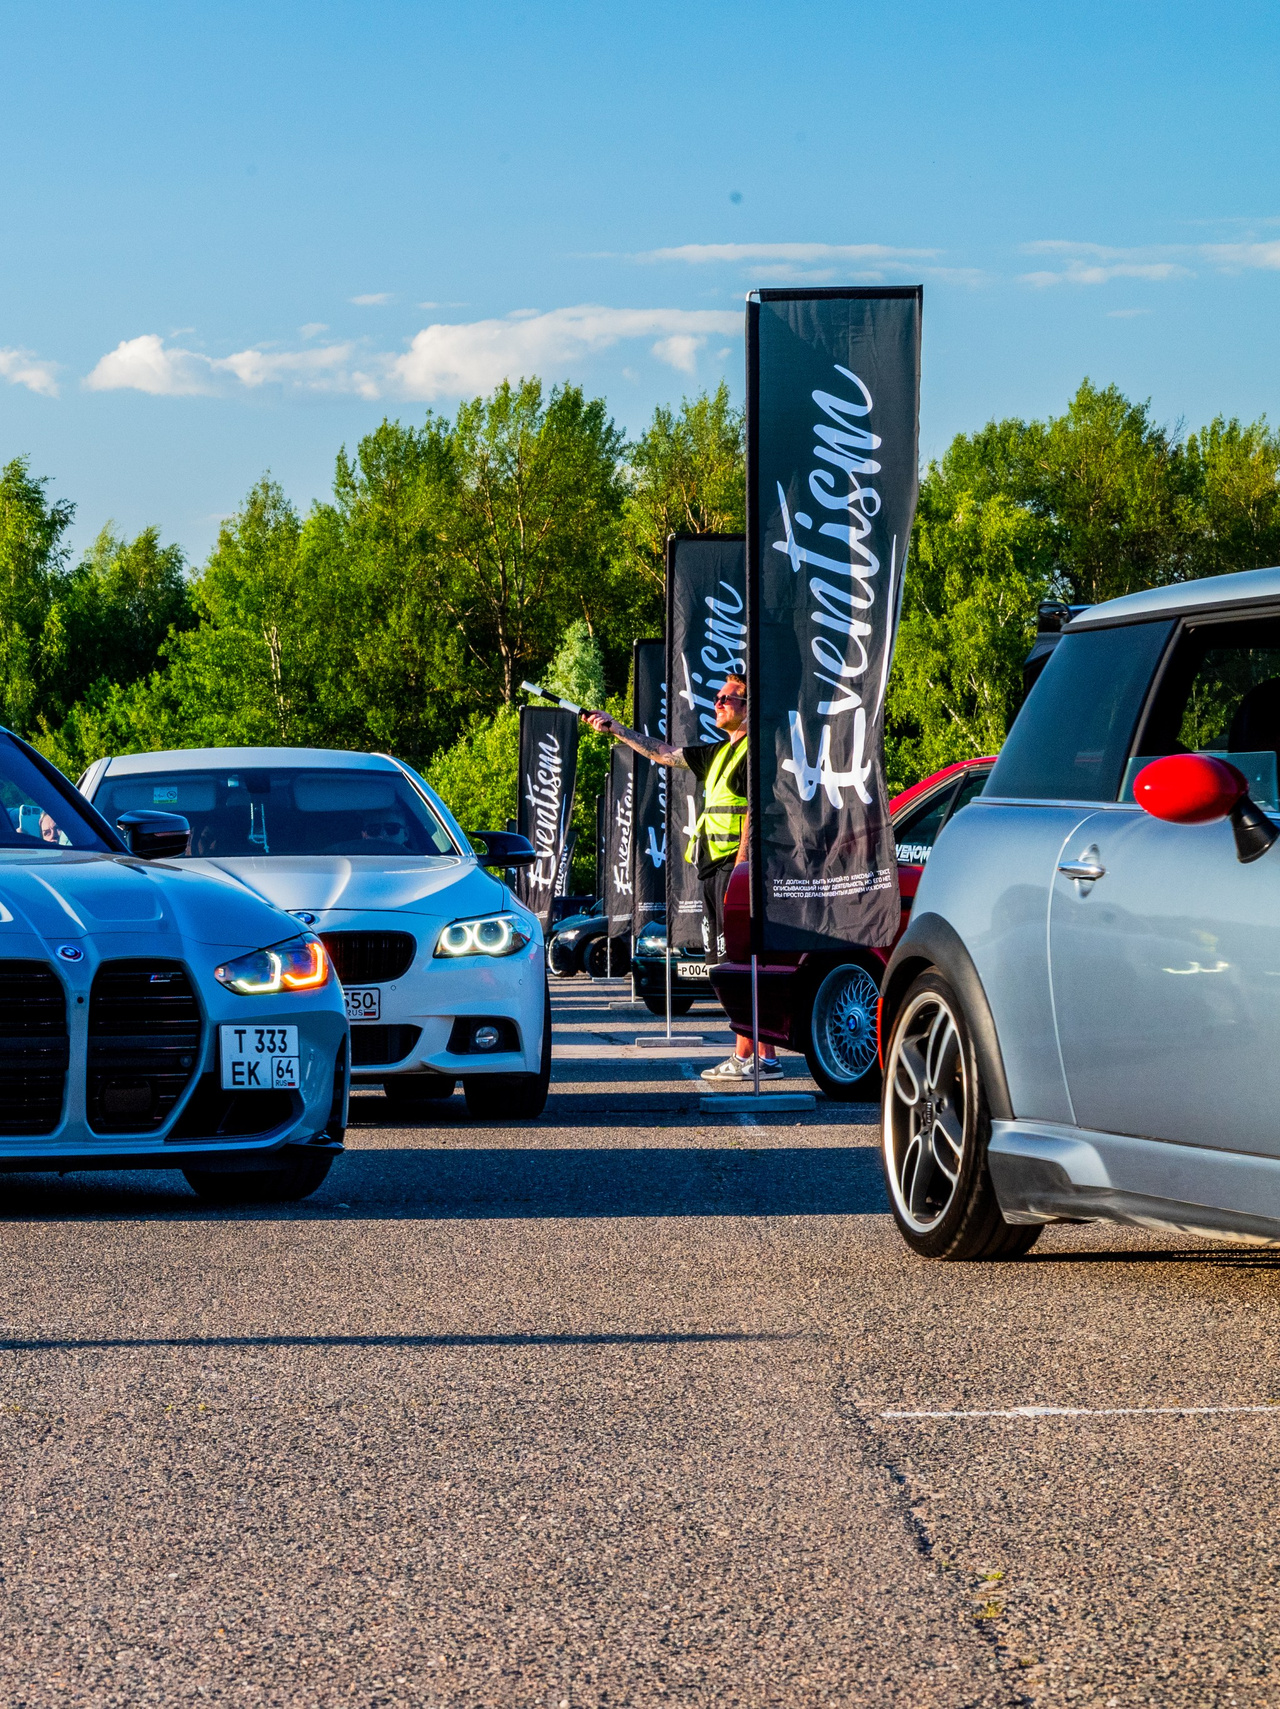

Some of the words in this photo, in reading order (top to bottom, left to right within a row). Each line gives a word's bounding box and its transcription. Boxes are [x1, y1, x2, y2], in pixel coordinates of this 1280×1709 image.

[772, 364, 883, 810] Eventism
[525, 733, 563, 892] Eventism
[895, 844, 932, 864] VENOM
[234, 1029, 247, 1053] T
[254, 1029, 287, 1053] 333
[232, 1061, 261, 1086] EK
[276, 1060, 293, 1078] 64
